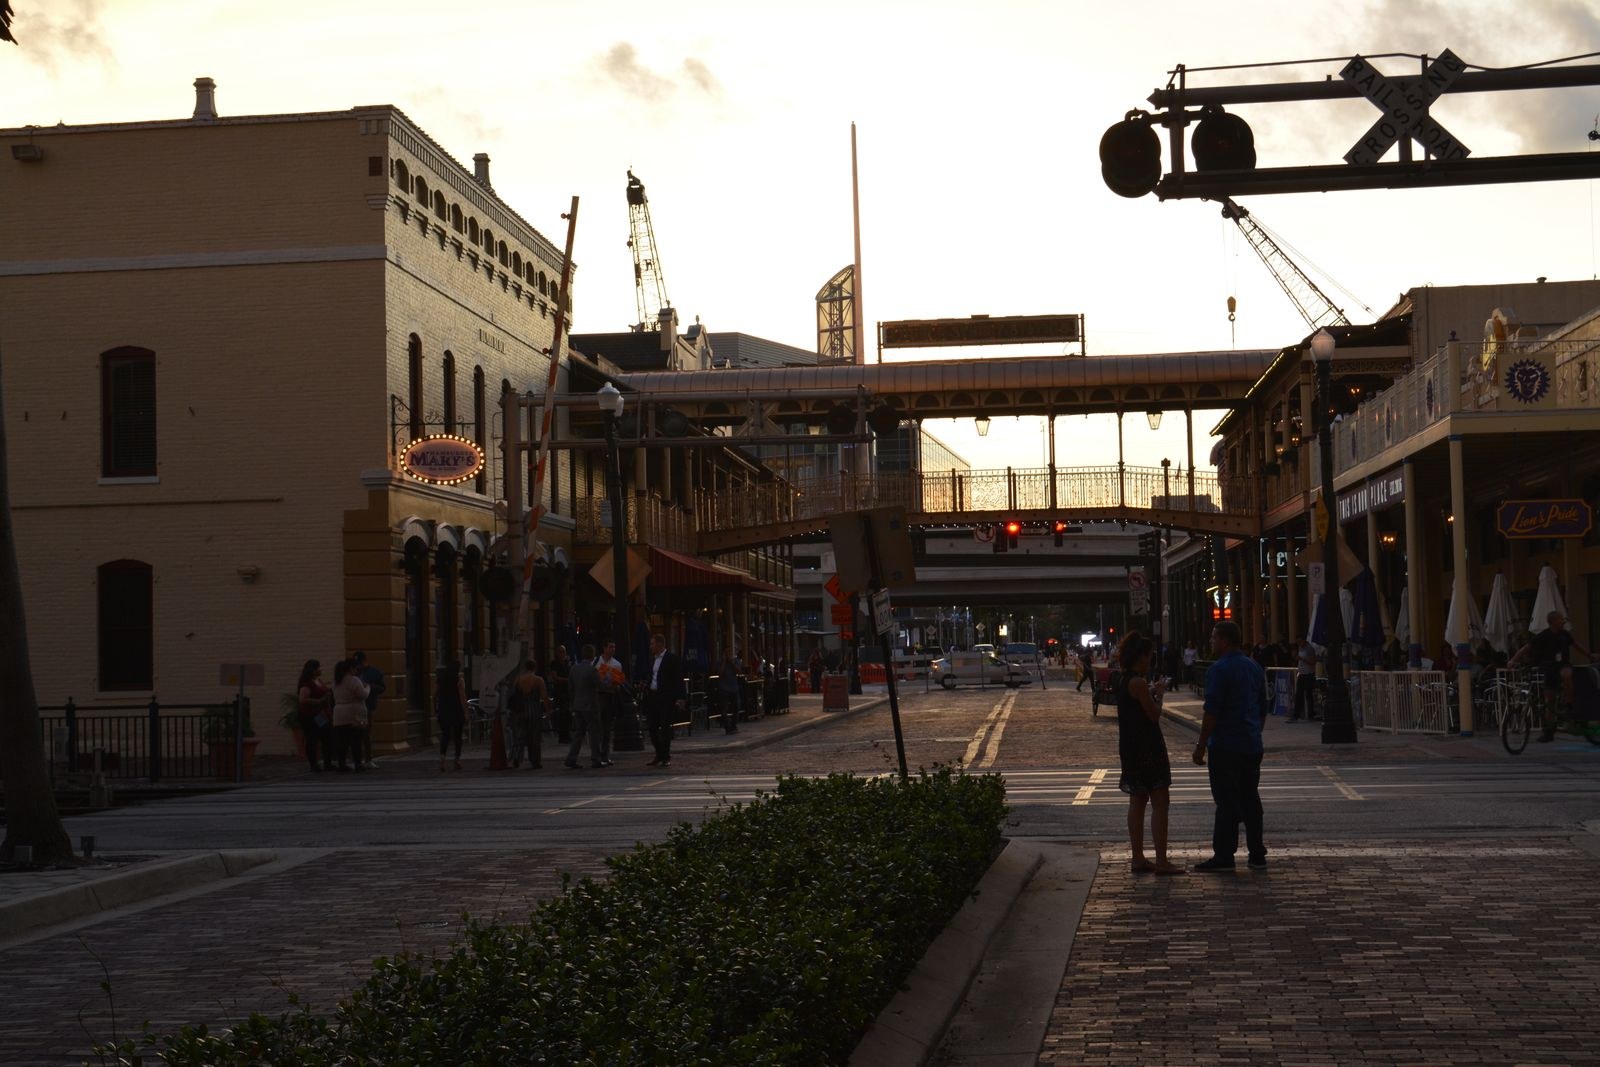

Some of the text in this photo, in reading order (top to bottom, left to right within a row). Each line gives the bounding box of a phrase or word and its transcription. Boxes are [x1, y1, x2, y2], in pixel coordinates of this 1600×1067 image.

[409, 451, 476, 466] MARY'S
[1507, 505, 1579, 533] Lion's Pride
